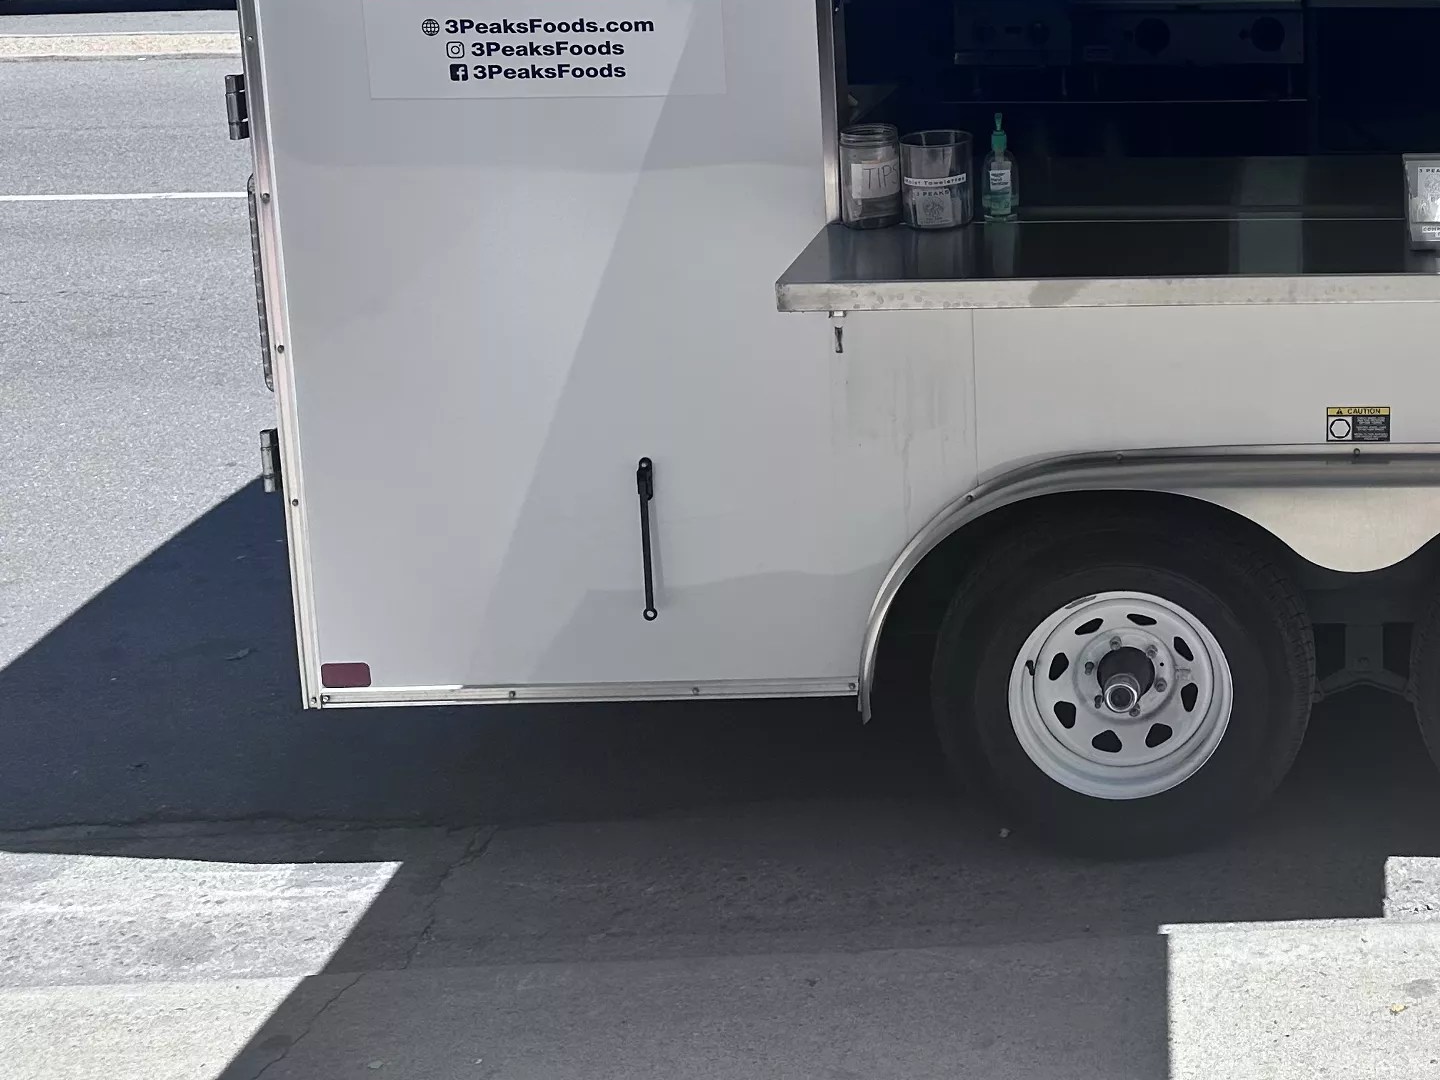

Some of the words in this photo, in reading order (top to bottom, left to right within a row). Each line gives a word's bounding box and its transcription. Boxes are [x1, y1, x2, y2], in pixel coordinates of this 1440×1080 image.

[445, 18, 654, 34] 3PeaksFoods.com
[471, 41, 624, 57] 3PeaksFoods
[473, 63, 626, 80] 3PeaksFoods
[863, 164, 899, 190] TIPS
